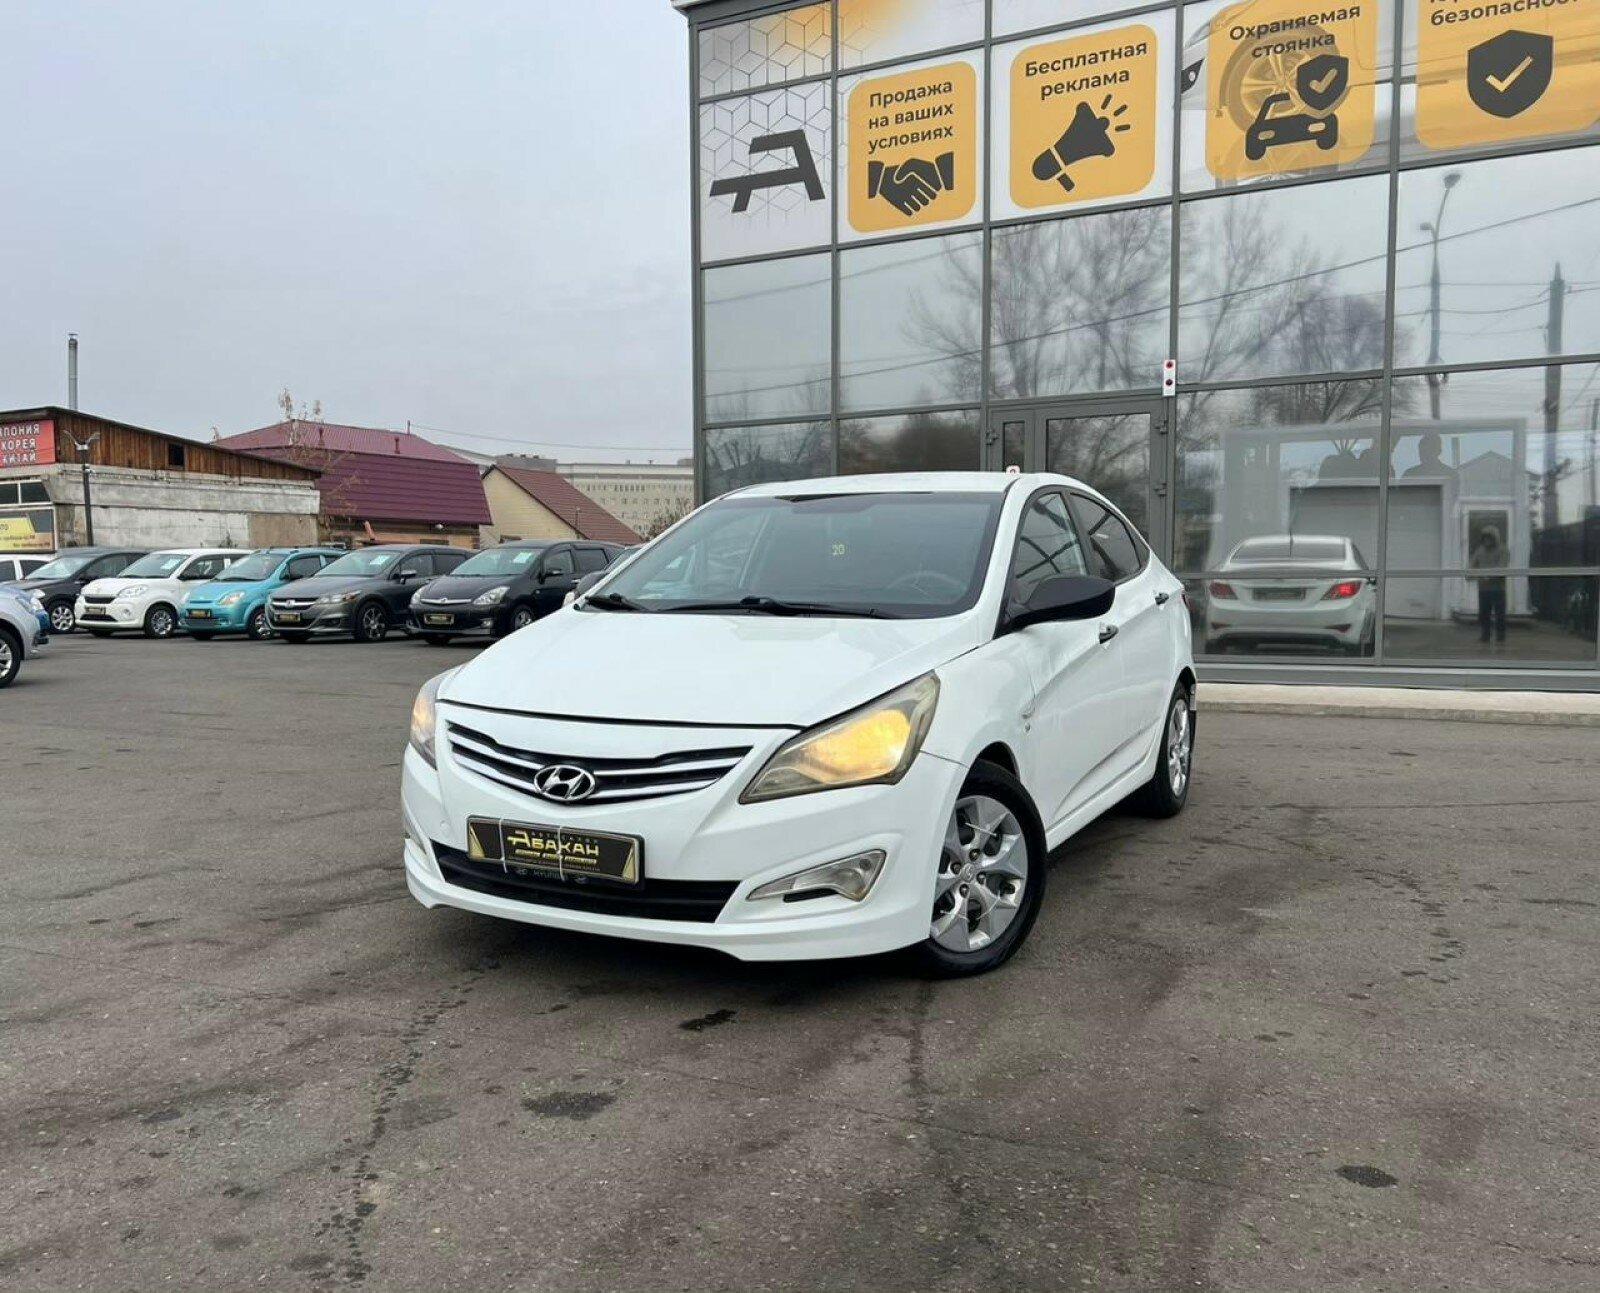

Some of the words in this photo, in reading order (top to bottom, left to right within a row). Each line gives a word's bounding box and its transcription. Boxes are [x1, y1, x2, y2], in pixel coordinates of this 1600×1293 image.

[1229, 5, 1361, 40] Охраняемая
[1025, 42, 1148, 77] Бесплатная
[1251, 33, 1336, 59] стоянка
[869, 82, 953, 109] Продажа
[1040, 69, 1131, 101] реклама
[868, 115, 890, 130] на
[894, 103, 954, 125] ваших
[868, 126, 954, 155] условиях
